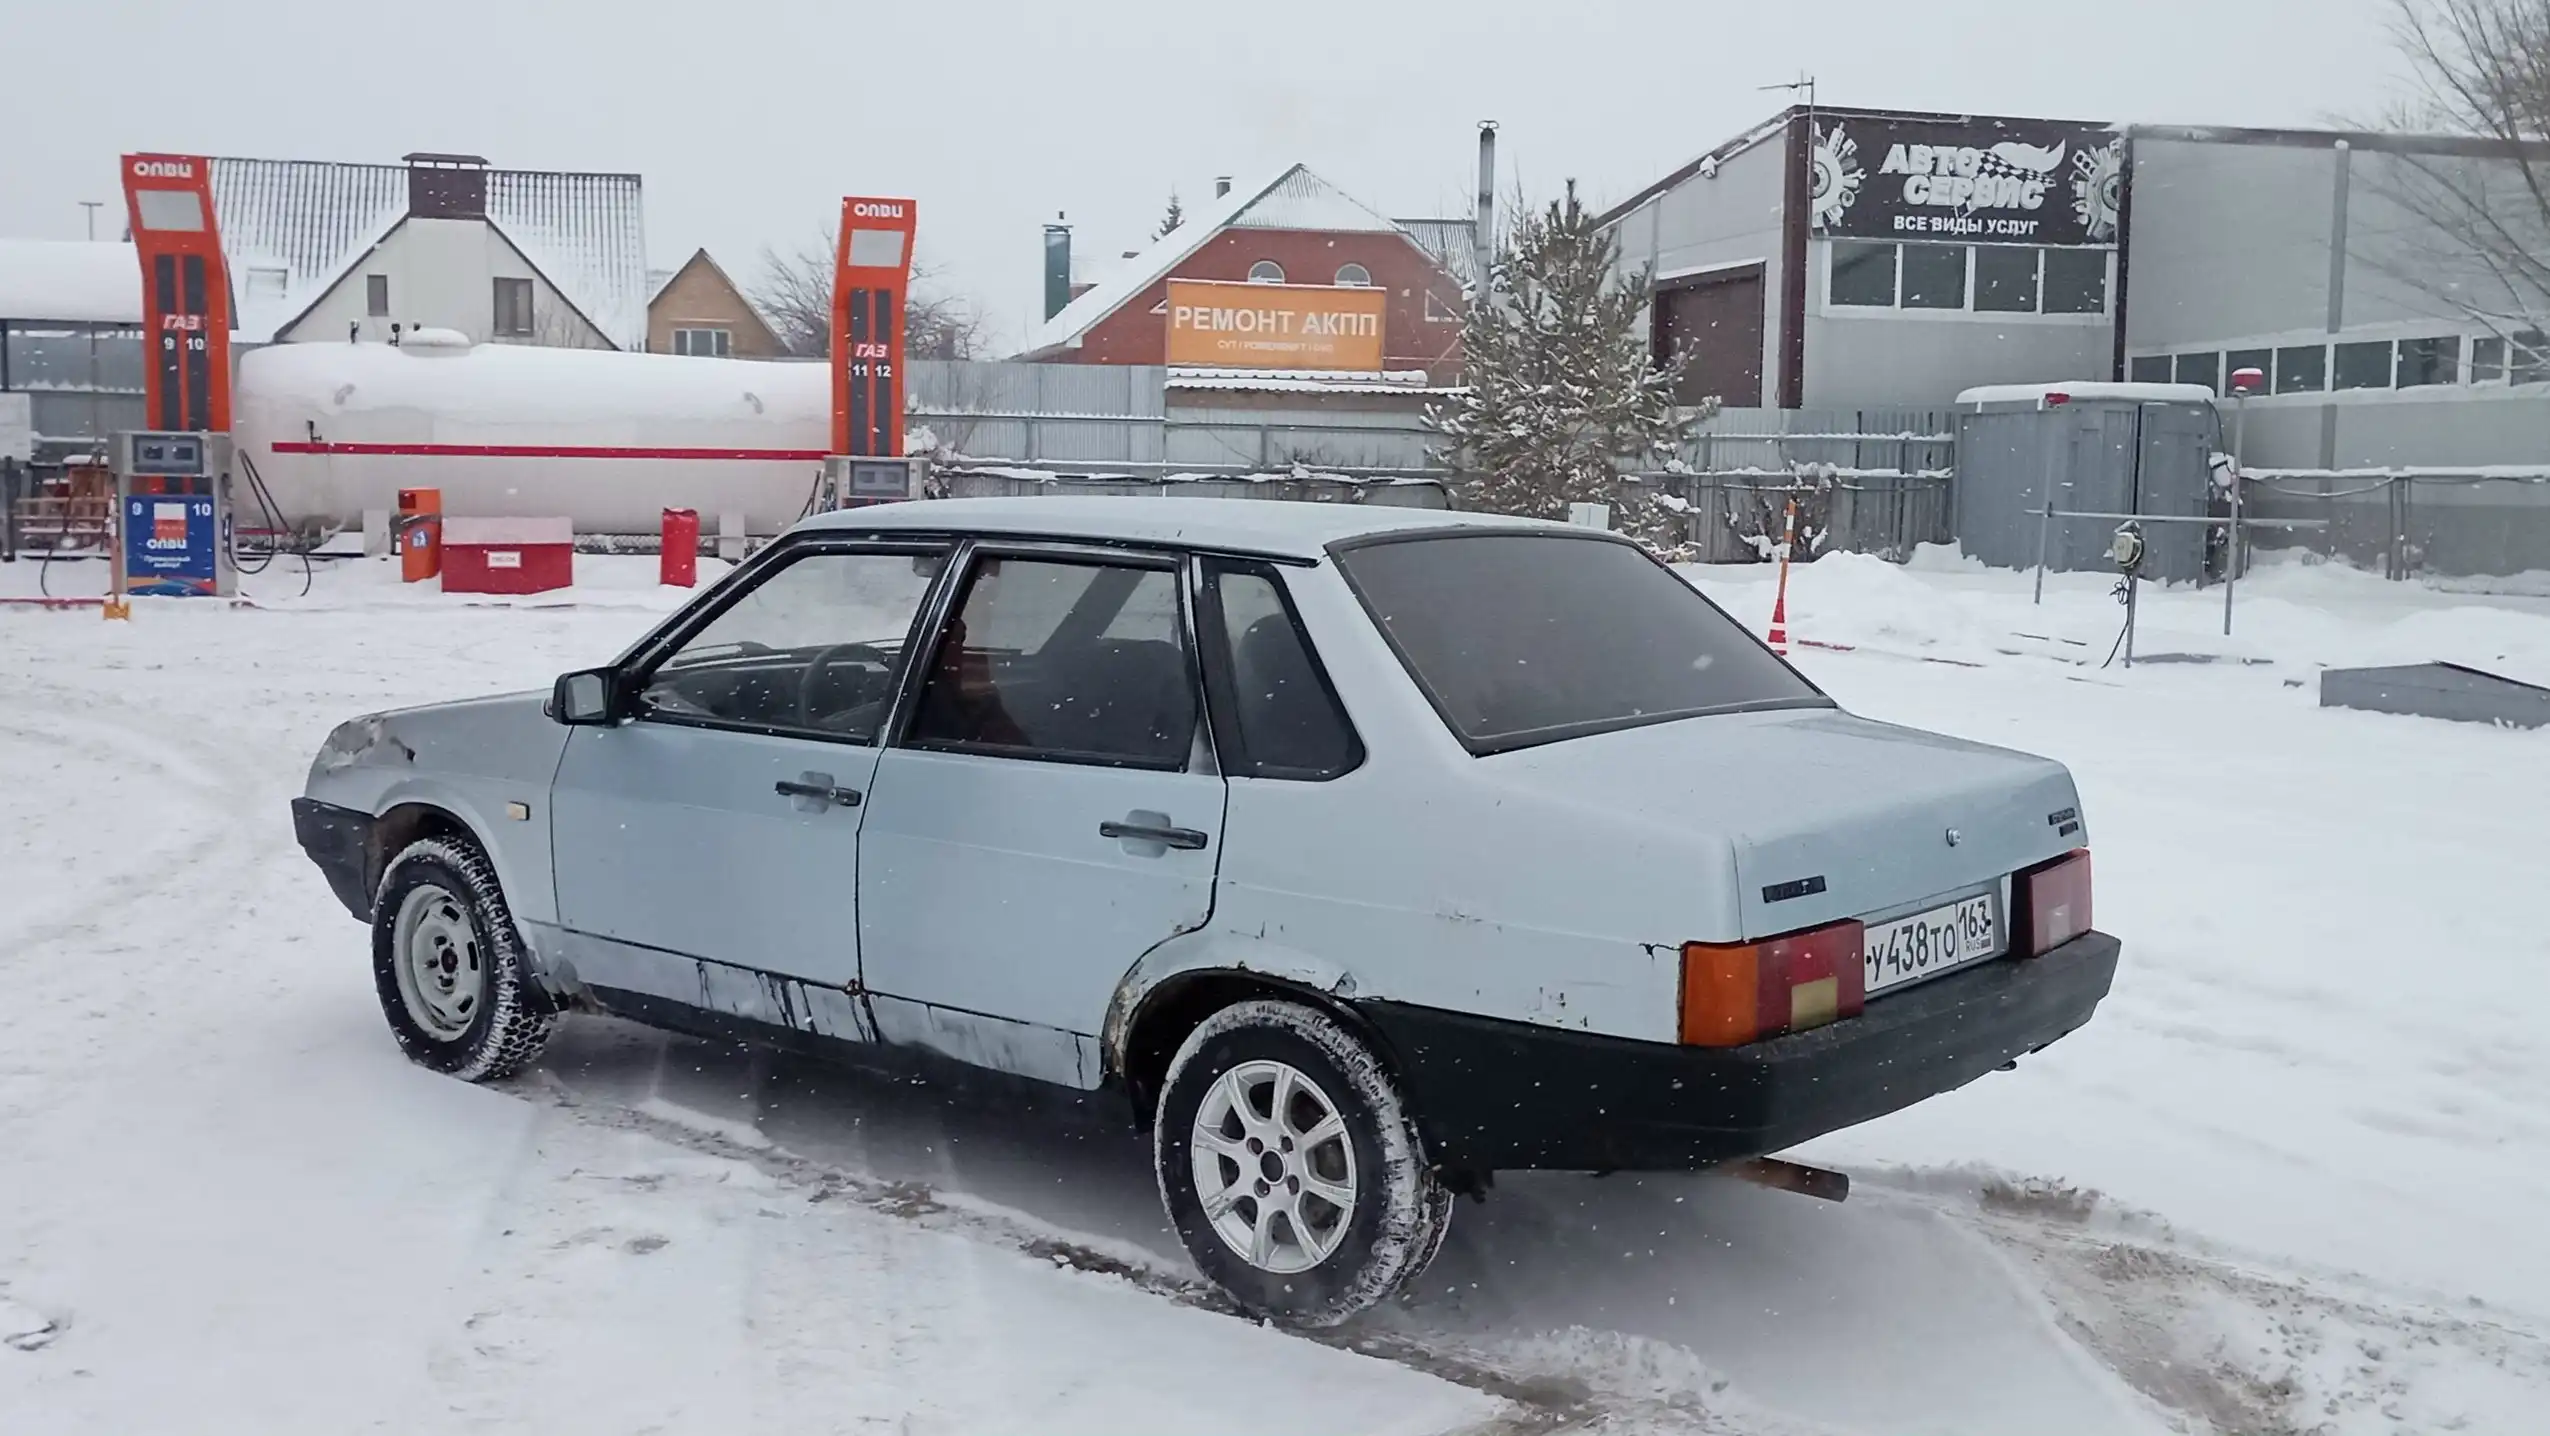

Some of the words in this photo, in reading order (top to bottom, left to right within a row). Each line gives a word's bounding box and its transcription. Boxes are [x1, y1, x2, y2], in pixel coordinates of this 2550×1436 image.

[1878, 143, 1982, 178] АВТО
[1903, 173, 2046, 210] СЕРВИС
[1893, 215, 1928, 231] ВСЕ
[1931, 216, 1983, 235] ВИДЫ
[1987, 219, 2039, 236] УСЛУГ
[163, 314, 200, 330] ГАЗ
[1174, 305, 1295, 333] РЕМОНТ
[1301, 312, 1377, 337] АКПП
[164, 337, 175, 350] 9
[186, 337, 205, 350] 10
[856, 344, 888, 358] ГАЗ
[852, 364, 868, 377] 11
[875, 364, 892, 378] 12
[192, 503, 212, 517] 10
[1958, 900, 1987, 940] 163
[1871, 921, 1956, 982] У438ТО
[1965, 938, 1982, 952] RUS
